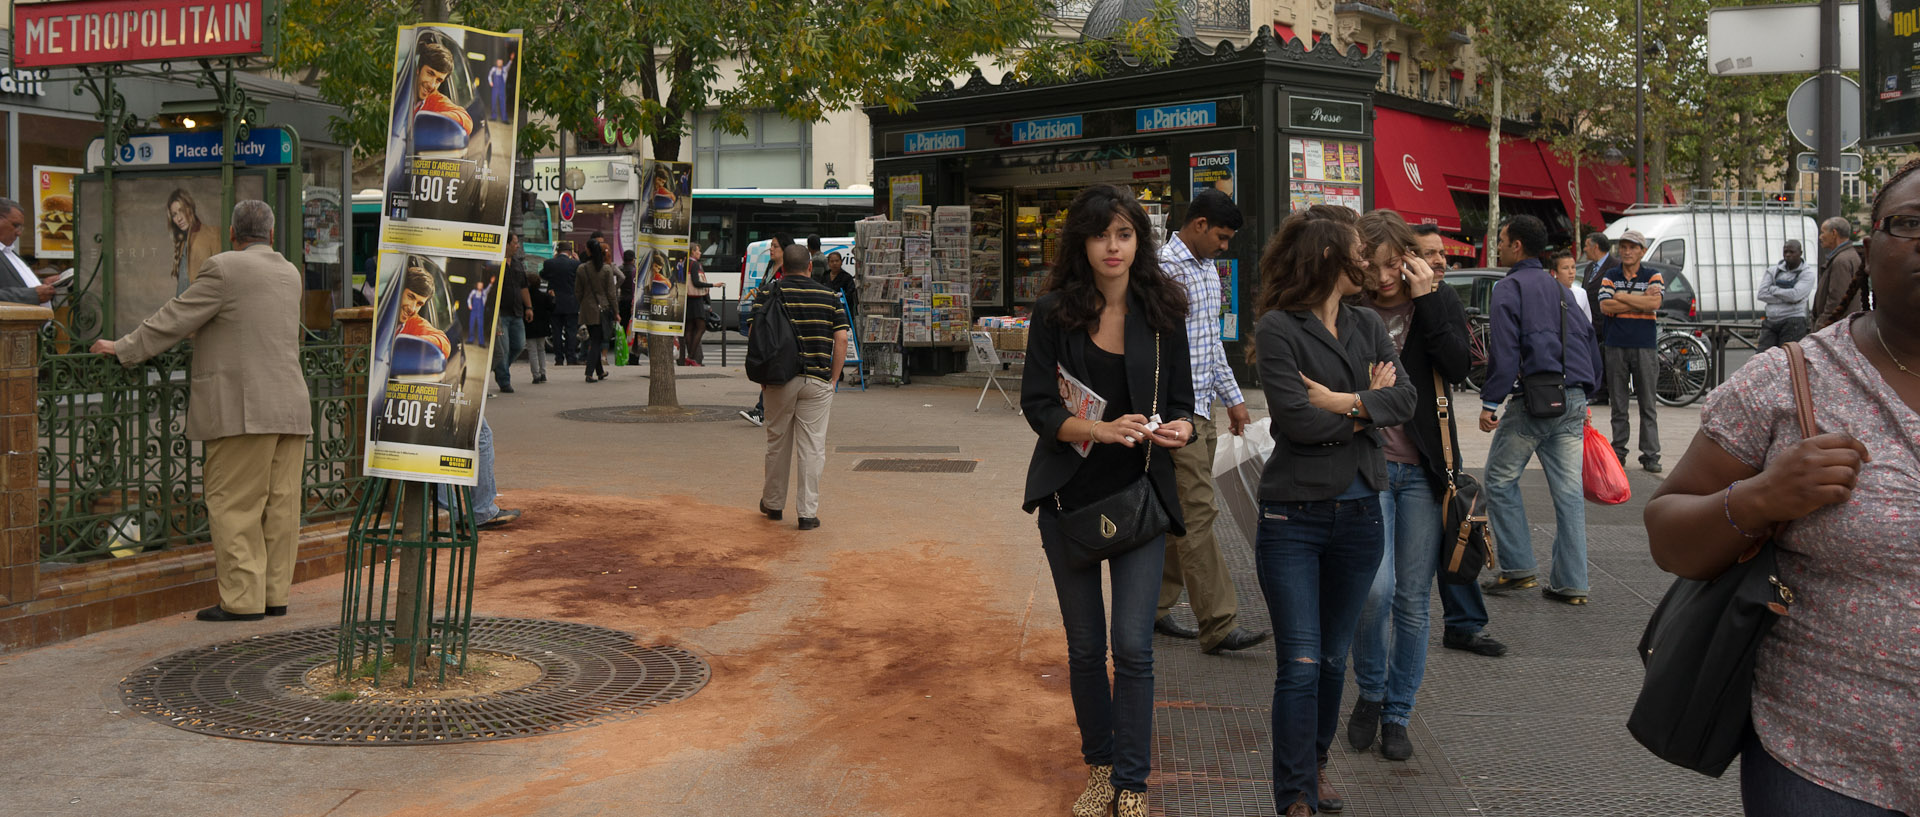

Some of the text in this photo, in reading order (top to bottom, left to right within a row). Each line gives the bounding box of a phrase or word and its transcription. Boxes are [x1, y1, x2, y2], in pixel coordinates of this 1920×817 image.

[25, 2, 250, 55] METROPOLITAIN
[1894, 8, 1920, 37] HOL
[1144, 107, 1209, 130] le Parisien
[1311, 107, 1343, 123] Presse
[1019, 120, 1076, 142] le Parisien
[124, 148, 132, 159] 2
[140, 147, 152, 158] 13
[175, 145, 208, 157] Place
[233, 143, 266, 157] lichy
[910, 132, 961, 151] le Parisien
[1207, 156, 1230, 166] revue
[90, 247, 158, 259] EPRIT
[384, 398, 421, 427] 4.90
[441, 455, 465, 463] WESTERN
